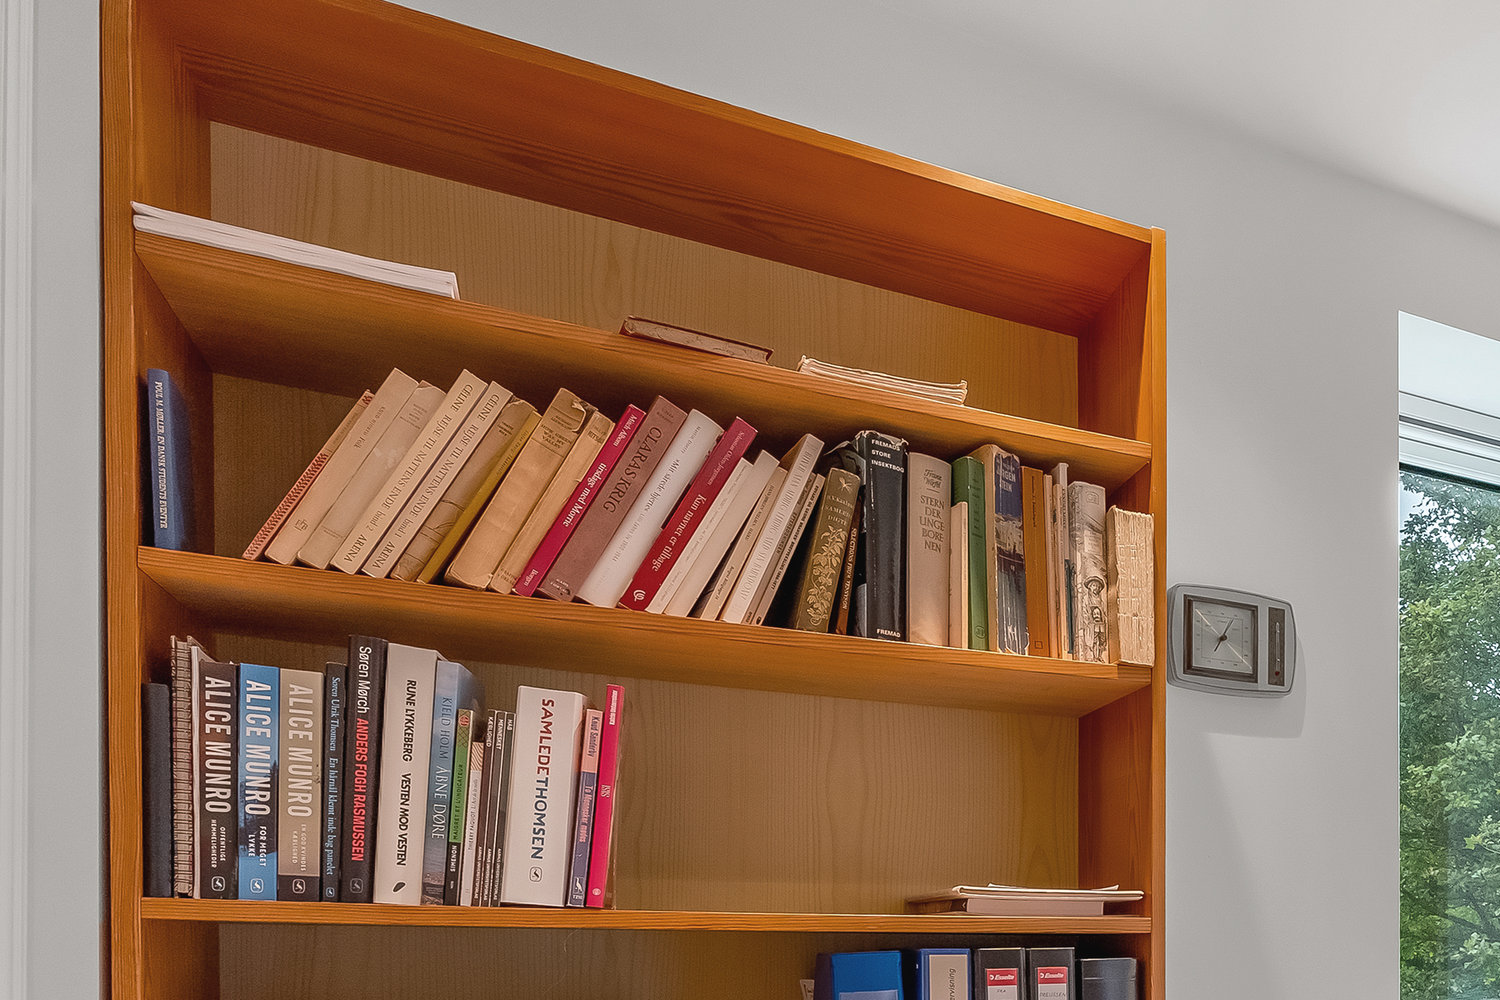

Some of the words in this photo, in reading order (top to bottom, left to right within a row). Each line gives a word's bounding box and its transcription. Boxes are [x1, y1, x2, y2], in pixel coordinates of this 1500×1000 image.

[460, 424, 478, 446] REJSE
[450, 447, 463, 459] TIL
[625, 426, 662, 479] CLARAS
[872, 450, 891, 458] STORE
[872, 459, 904, 473] INSEKTBOG
[426, 460, 454, 496] NATTENS
[586, 462, 607, 489] tirsdage
[410, 494, 430, 517] ENDE
[577, 488, 590, 504] med
[603, 477, 631, 513] KRIG
[690, 494, 706, 512] Kun
[920, 495, 945, 510] STERN
[563, 502, 583, 527] Morrie
[674, 510, 694, 536] navnet
[920, 516, 945, 531] UNGE
[925, 506, 942, 519] DER
[922, 528, 944, 542] BORE
[924, 540, 941, 553] NEN
[372, 541, 395, 569] ARENA
[652, 544, 672, 571] tilbage
[876, 629, 900, 638] FREMAD
[358, 647, 372, 677] Søren
[205, 676, 231, 735] ALICE
[357, 681, 370, 713] Mørch
[405, 680, 416, 706] RUNE
[245, 680, 271, 738] ALICE
[289, 684, 313, 740] ALICE
[441, 697, 453, 725] KJELD
[355, 718, 368, 761] ANDERS
[402, 709, 415, 761] LYKKEBERG
[440, 730, 450, 759] HOLM
[205, 741, 231, 813] MUNRO
[245, 745, 271, 815] MUNRO
[287, 747, 312, 816] MUNRO
[354, 763, 367, 792] FOGH
[400, 773, 411, 805] VESTEN
[434, 766, 450, 798] ÅBNE
[531, 699, 555, 859] SAMLEDETHOMSEN
[351, 794, 366, 860] RASMUSSEN
[398, 808, 409, 830] MOD
[432, 804, 447, 839] DØRE
[248, 834, 256, 857] LYKKE
[259, 844, 267, 866] MEGET
[396, 833, 408, 865] VESTEN
